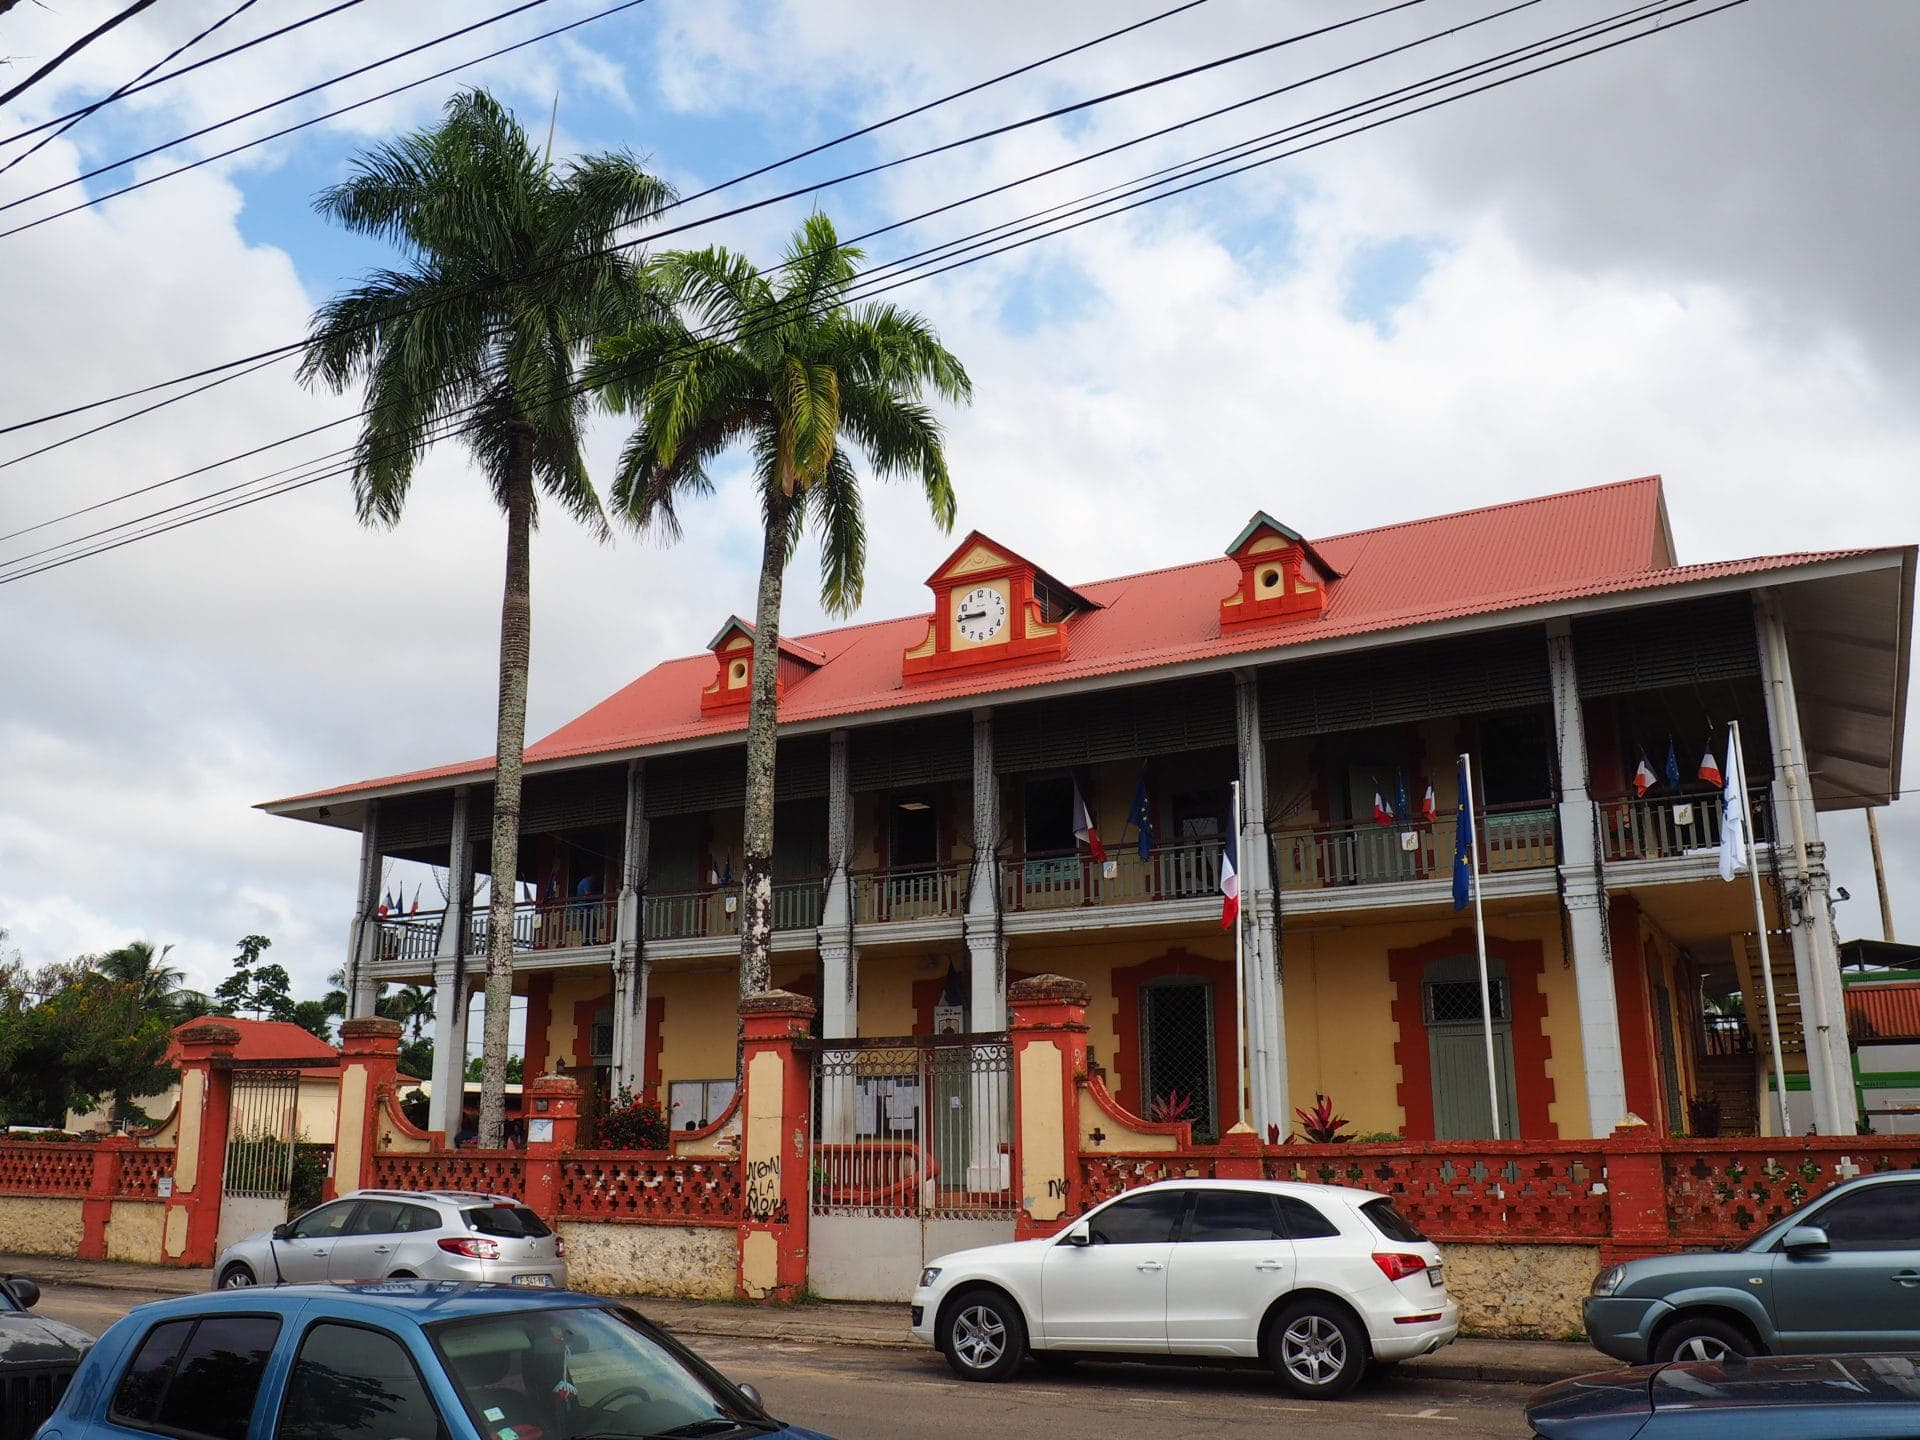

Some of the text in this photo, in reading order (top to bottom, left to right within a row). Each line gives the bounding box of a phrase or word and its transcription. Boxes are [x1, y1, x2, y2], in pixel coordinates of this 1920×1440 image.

[977, 589, 984, 598] 12
[995, 596, 1001, 605] 2
[999, 606, 1005, 615] 3
[996, 618, 1001, 627] 4
[961, 625, 966, 634] 8
[989, 627, 994, 636] 5
[969, 631, 975, 639] 7
[978, 632, 984, 641] 6
[746, 1155, 780, 1181] NON
[759, 1179, 775, 1198] LA
